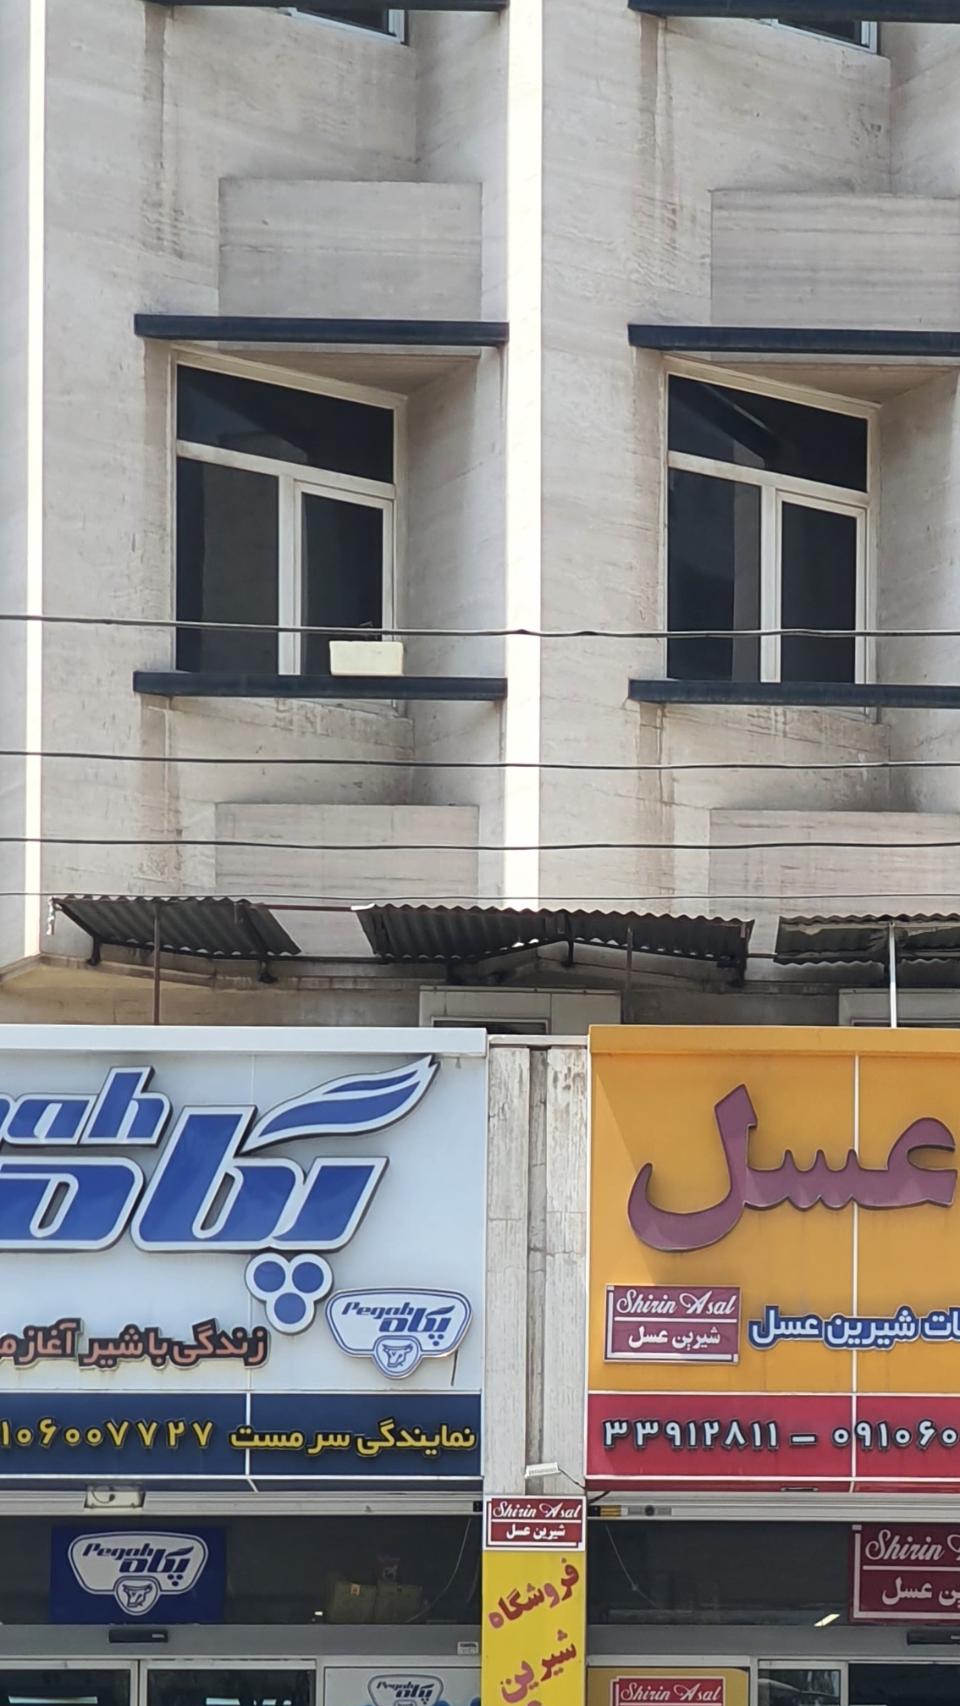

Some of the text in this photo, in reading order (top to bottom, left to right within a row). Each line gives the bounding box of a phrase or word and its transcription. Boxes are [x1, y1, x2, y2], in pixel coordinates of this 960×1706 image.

[627, 1083, 958, 1253] عسل
[341, 1301, 415, 1320] Pegah
[616, 1288, 737, 1315] Shirin Asal
[15, 1319, 80, 1367] آغاز
[172, 1319, 269, 1368] زندگی
[378, 1304, 456, 1347] پگاه
[628, 1325, 721, 1351] شیرین عسل
[750, 1306, 822, 1348] عسل
[825, 1306, 919, 1349] شیرین
[80, 1325, 145, 1368] شیر
[148, 1328, 170, 1368] با
[357, 1421, 476, 1458] نمایندگی
[492, 1500, 582, 1518] Shirin Asal
[82, 1543, 154, 1560] Pegah
[506, 1523, 566, 1540] شیرین عسل
[865, 1529, 945, 1561] Shirin
[118, 1546, 195, 1587] پگاه
[488, 1557, 580, 1629] فروشگاه
[881, 1576, 933, 1605] عسل
[500, 1629, 577, 1703] شیرین
[621, 1682, 722, 1701] Shirin Asal
